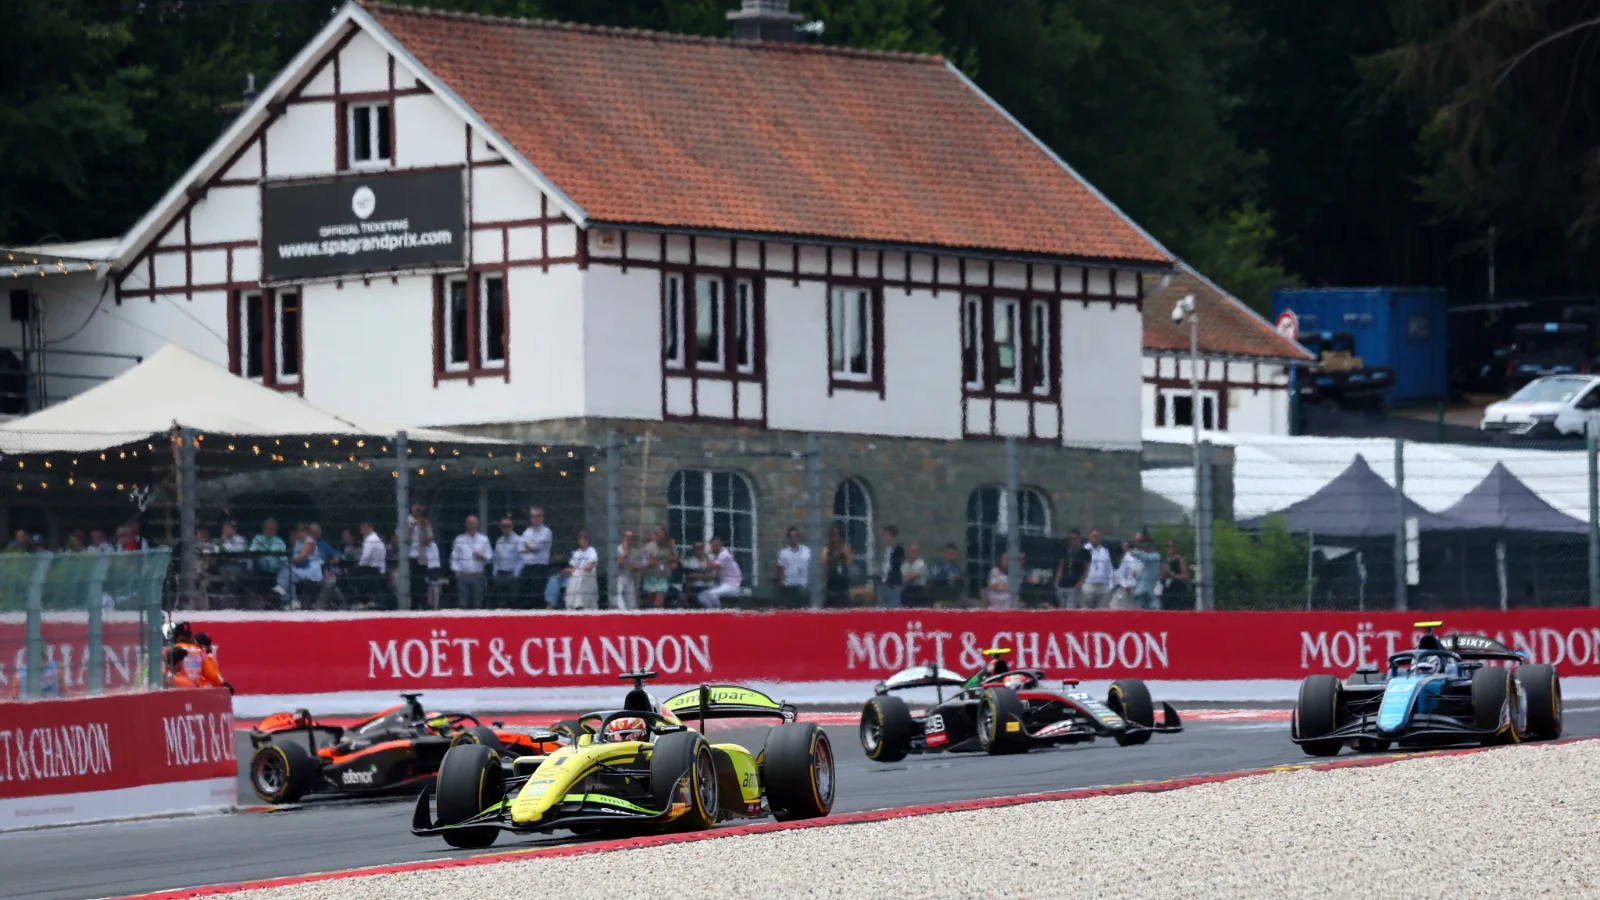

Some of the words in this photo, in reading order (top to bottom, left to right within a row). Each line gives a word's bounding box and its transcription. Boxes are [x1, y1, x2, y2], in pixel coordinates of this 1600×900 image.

[278, 230, 452, 258] www.spagrandprix.com
[319, 225, 360, 237] OFFICIAL
[360, 218, 409, 233] TICKETING
[368, 629, 480, 679] MOËT
[488, 636, 516, 678] &
[520, 634, 714, 676] CHANDON
[846, 620, 952, 670] MOËT
[958, 631, 985, 670] &
[1300, 621, 1403, 669] MOËT
[674, 689, 747, 706] amipar
[15, 726, 31, 782] &
[29, 722, 113, 780] CHANDON
[162, 702, 208, 767] MOËT
[208, 711, 221, 764] &
[341, 769, 374, 785] edenor
